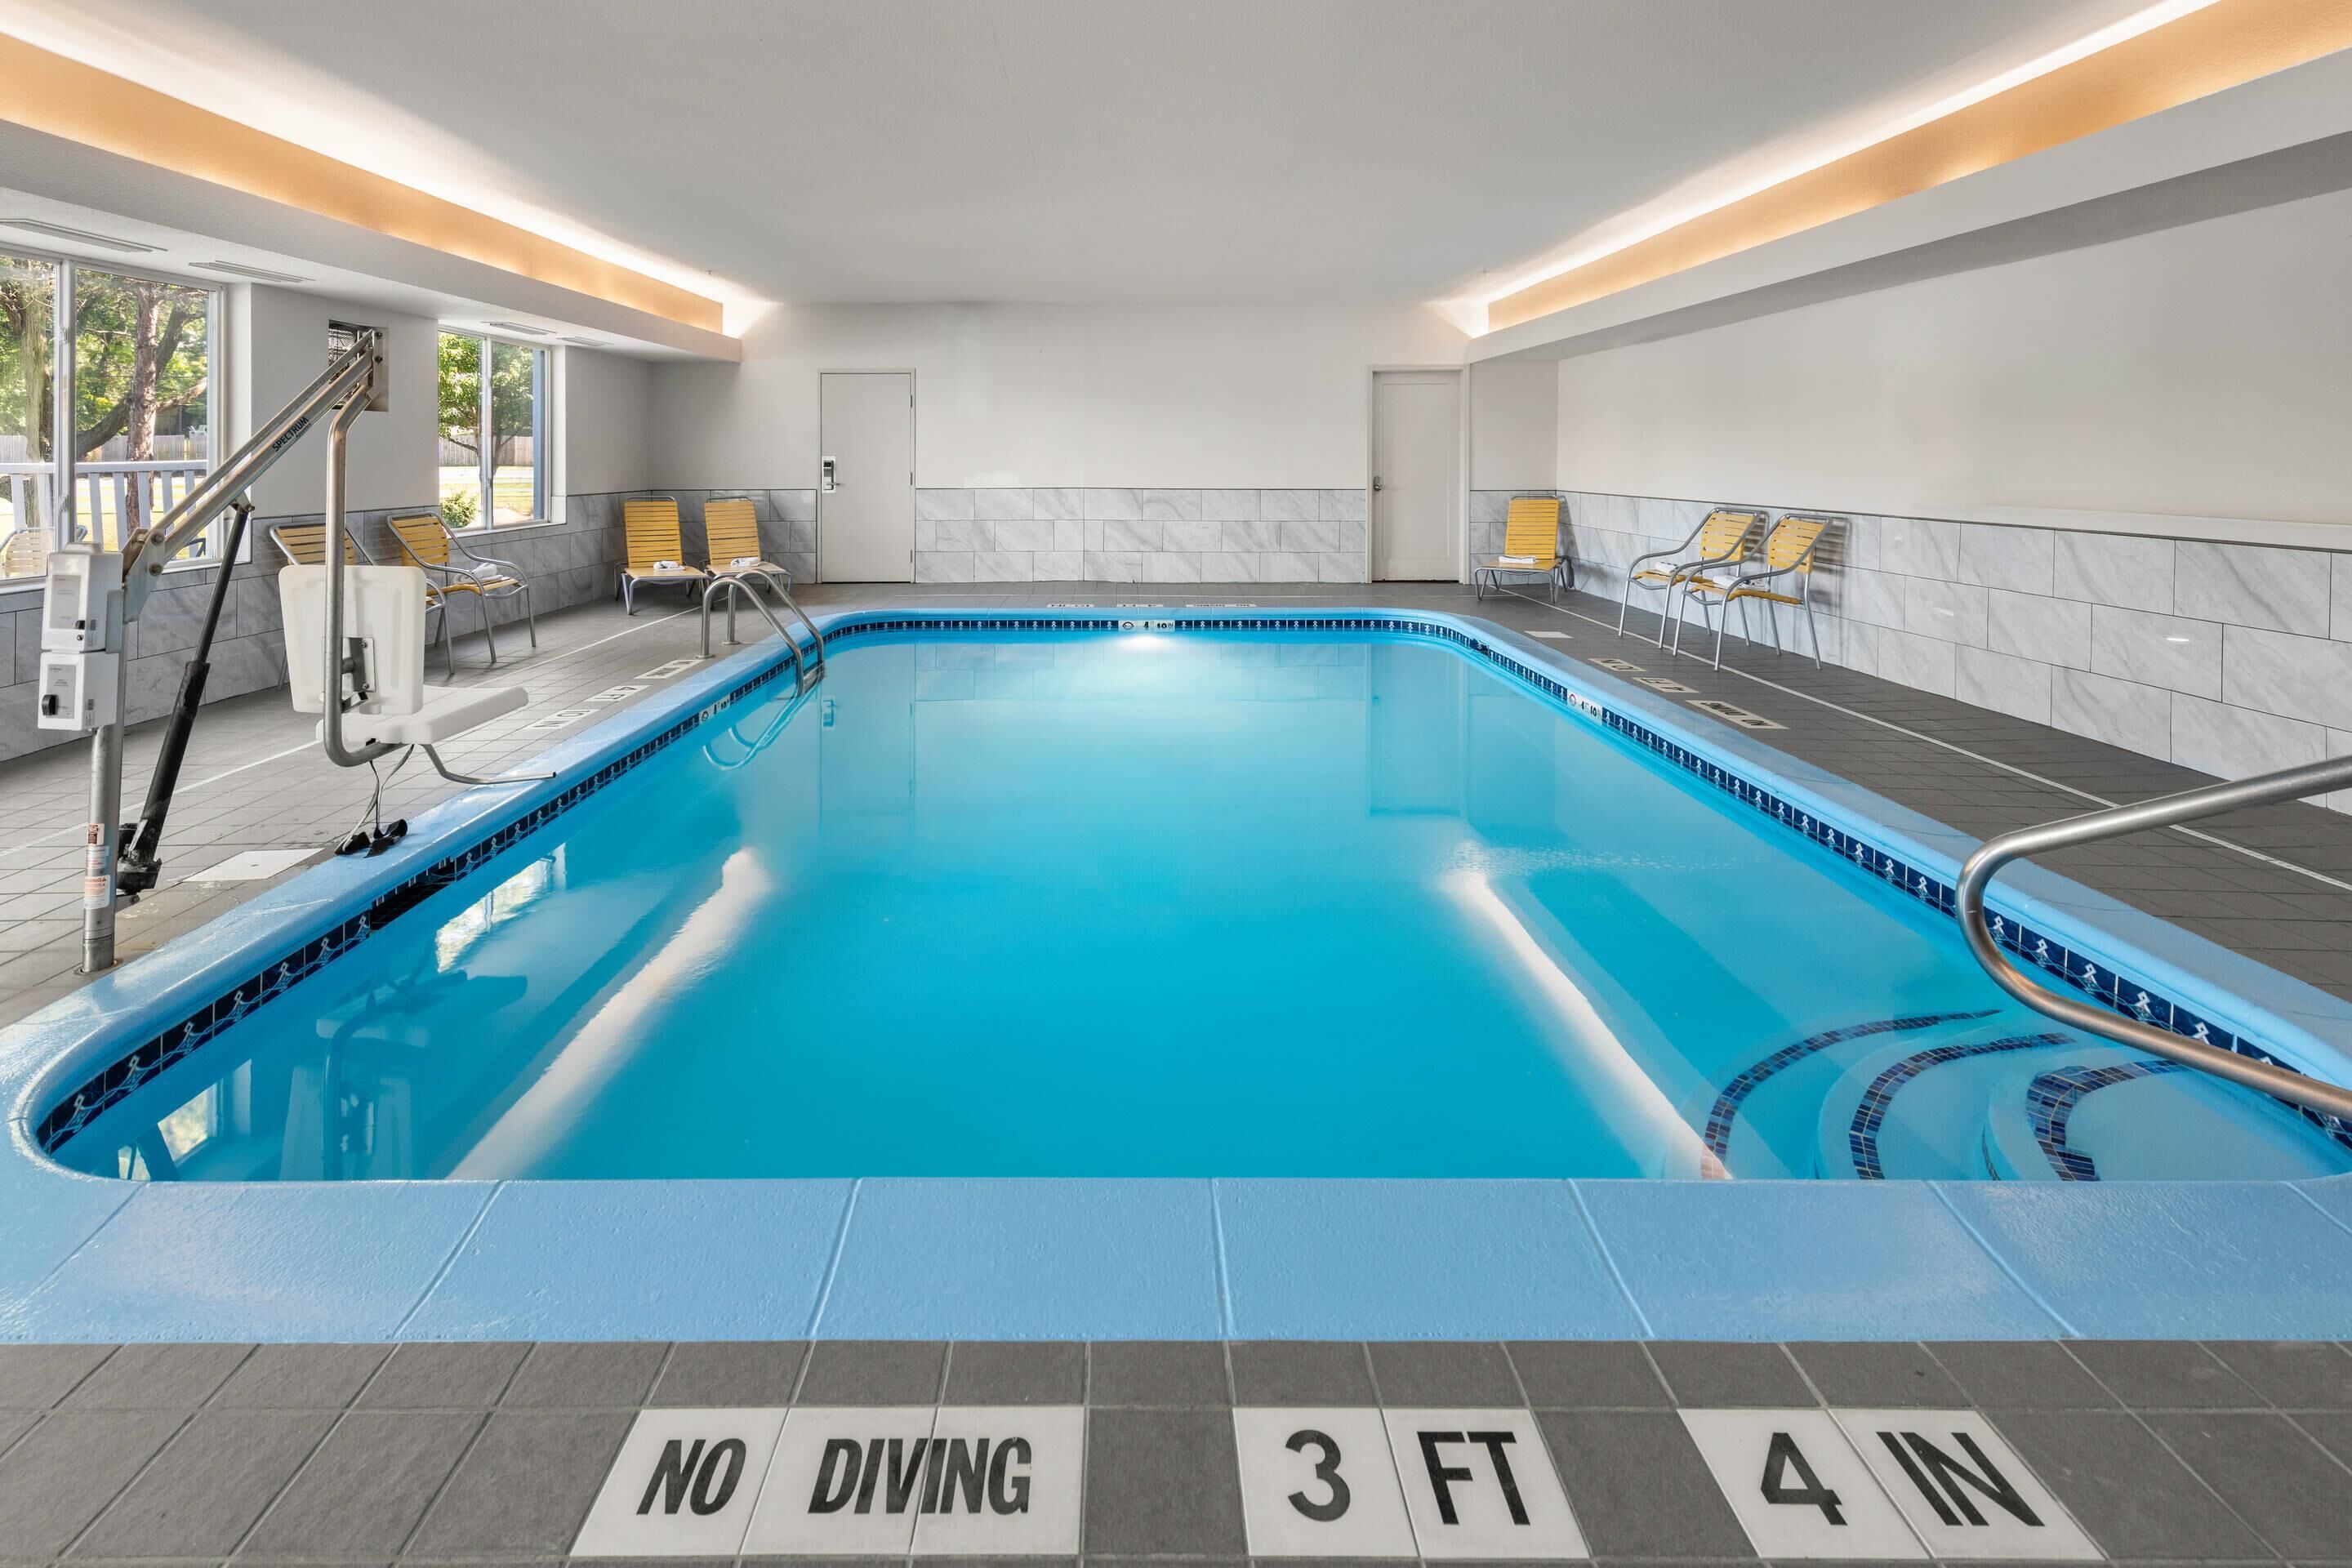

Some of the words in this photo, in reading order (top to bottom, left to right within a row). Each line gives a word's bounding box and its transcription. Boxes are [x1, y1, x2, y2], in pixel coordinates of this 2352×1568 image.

[272, 416, 310, 452] SPECTRUM
[1590, 706, 1597, 716] 10
[635, 1437, 747, 1517] NO
[807, 1437, 1033, 1516] DIVING
[1285, 1429, 1351, 1523] 3
[1416, 1430, 1530, 1526] FT
[1759, 1432, 1847, 1526] 4
[1875, 1431, 2047, 1526] IN
